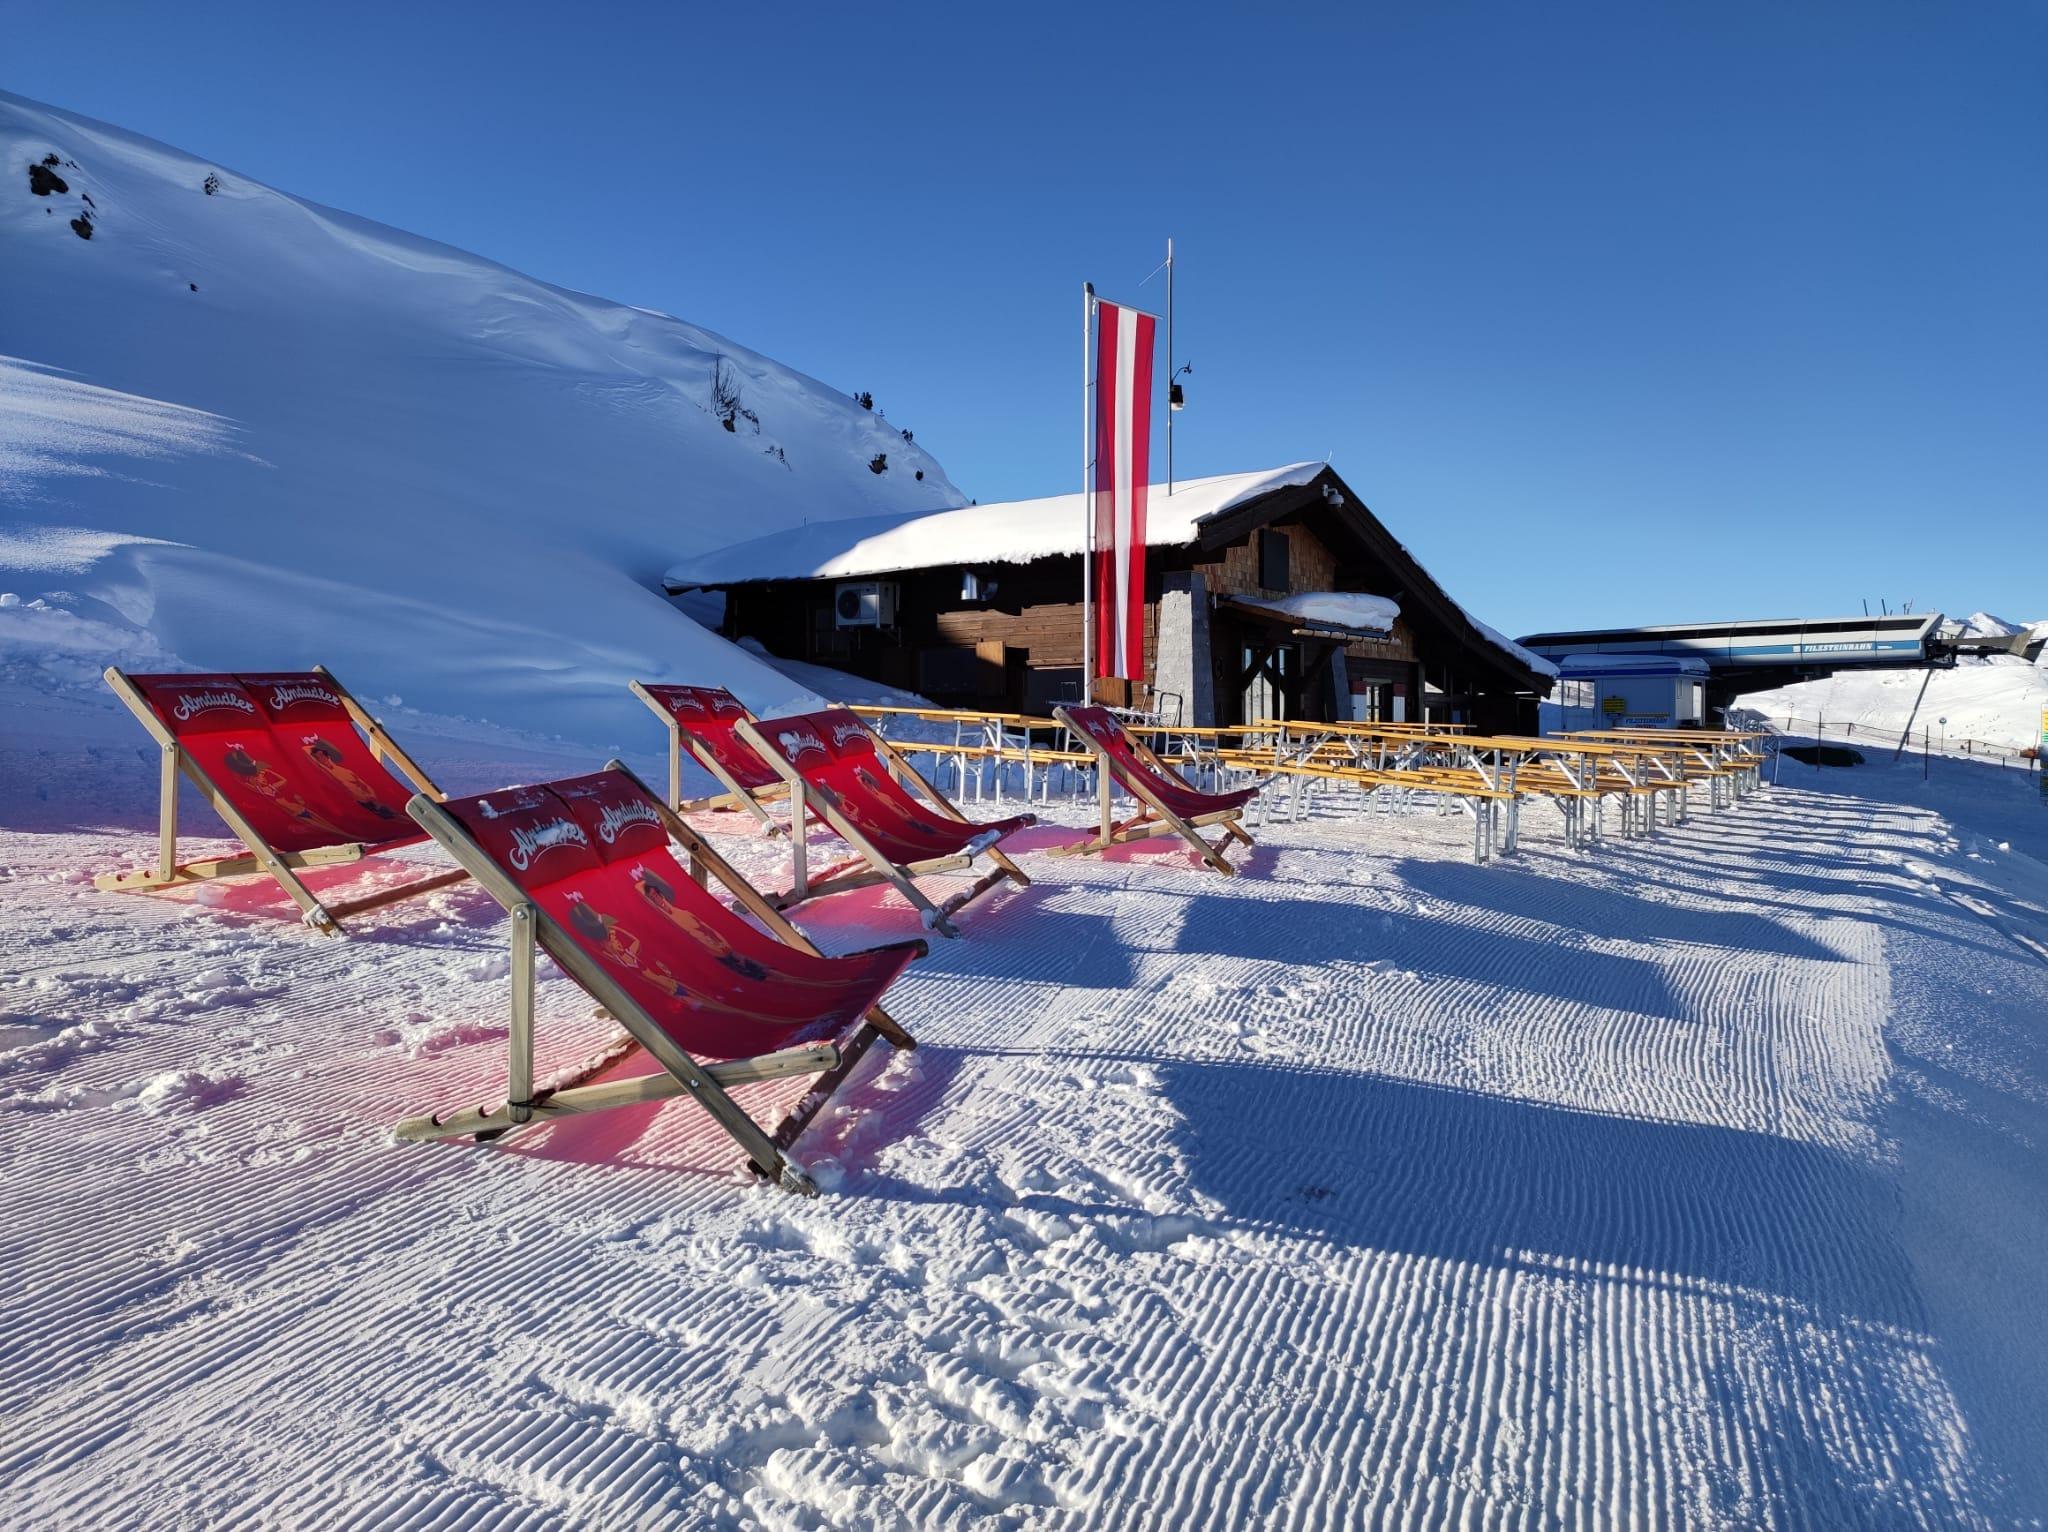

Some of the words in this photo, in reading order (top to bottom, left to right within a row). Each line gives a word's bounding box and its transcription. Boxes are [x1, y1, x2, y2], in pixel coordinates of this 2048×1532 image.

[174, 691, 255, 721] Almdudler
[270, 685, 341, 710] Almdudler
[599, 798, 660, 845] Almdudler
[509, 816, 588, 871] Almler
